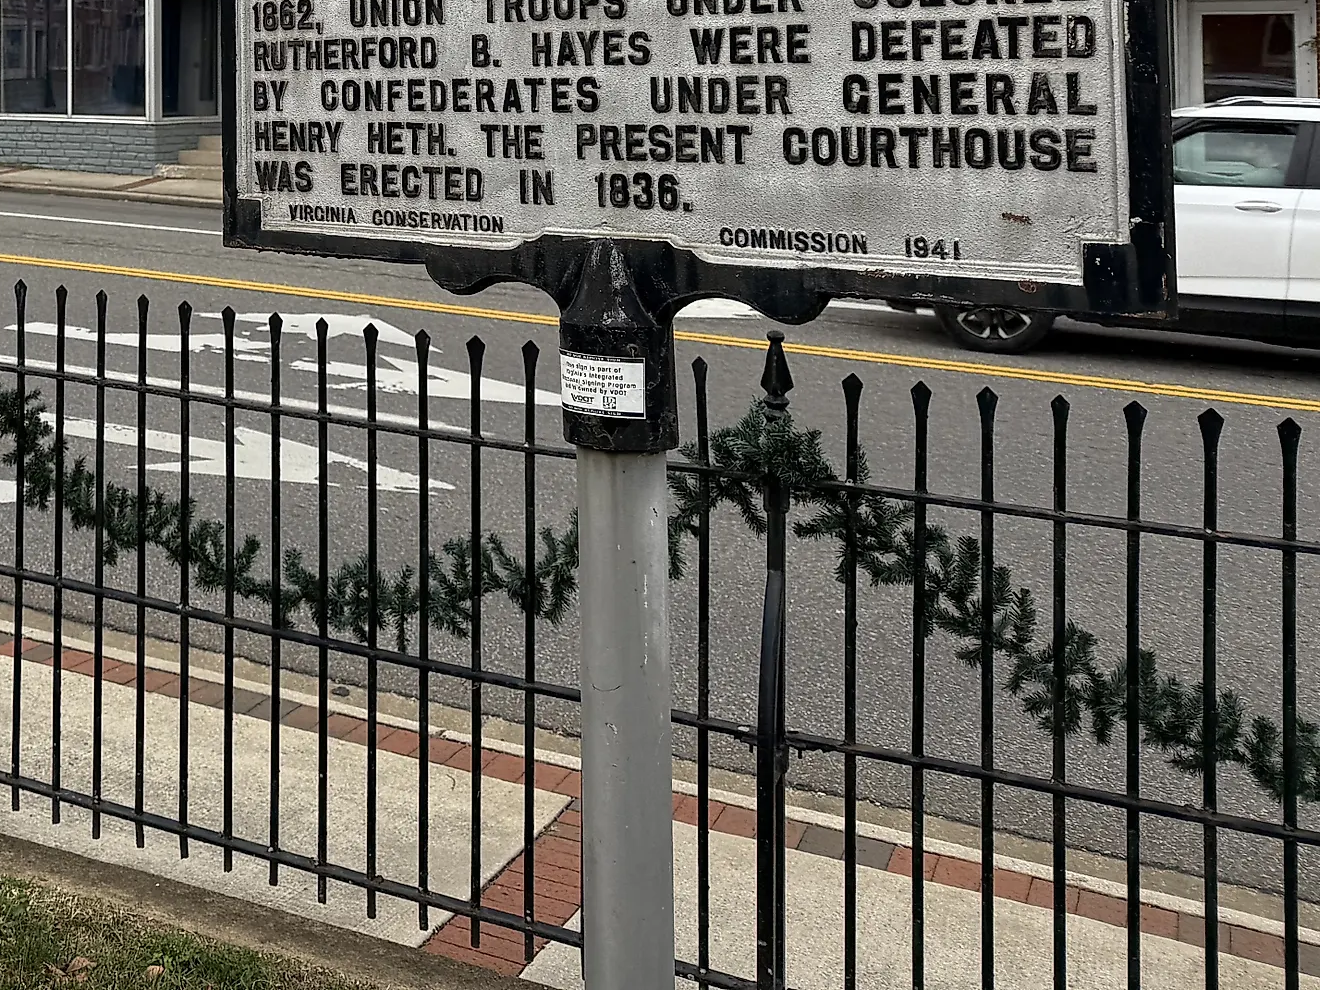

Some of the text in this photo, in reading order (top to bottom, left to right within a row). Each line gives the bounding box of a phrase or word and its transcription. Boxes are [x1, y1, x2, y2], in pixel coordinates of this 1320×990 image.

[254, 15, 1097, 71] RUTHERFORD B. HAYES WERE DEFEATED
[253, 71, 1098, 116] BY CONFEDERATES UNDER GENERAL
[254, 121, 1098, 173] HENRY HETH. THE PRESENT COURTHOUSE
[254, 161, 693, 212] WAS ERECTED IN 1836.
[288, 204, 962, 260] VIRGINIA CONSERVATION COMMISSION 1941
[588, 371, 624, 381] Integrated
